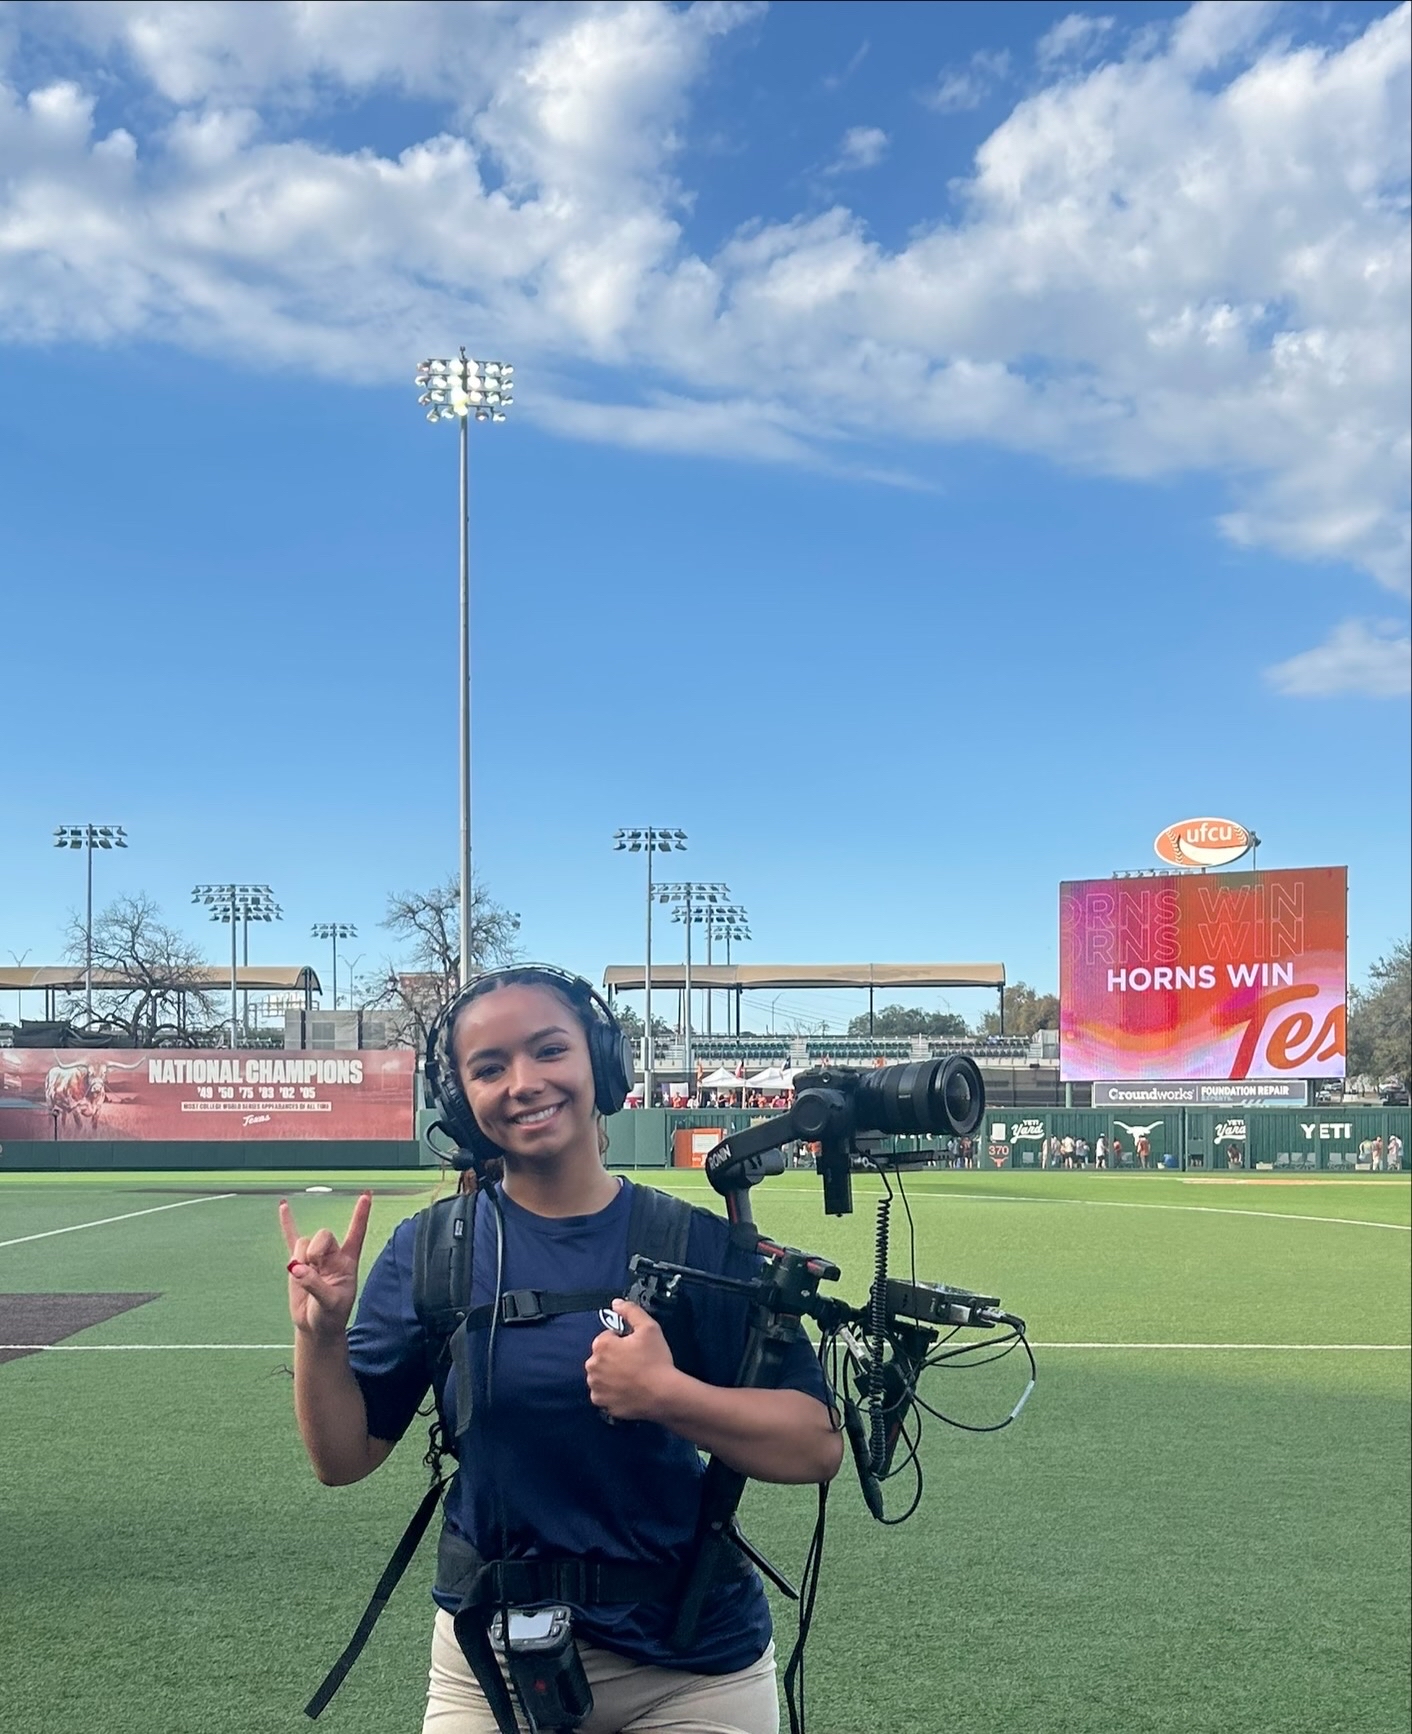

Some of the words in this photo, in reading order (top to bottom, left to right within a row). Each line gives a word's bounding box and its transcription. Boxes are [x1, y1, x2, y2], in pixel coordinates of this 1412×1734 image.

[1187, 822, 1232, 843] ufcu
[1198, 882, 1304, 924] WIN
[1198, 919, 1304, 960] WIN
[1107, 965, 1216, 992] HORNS
[1226, 962, 1294, 988] WIN
[148, 1059, 243, 1084] NATIONAL
[245, 1059, 363, 1084] CHAMPIONS
[197, 1086, 213, 1099] '49
[239, 1086, 254, 1099] '75
[1108, 1087, 1193, 1101] Groundworks
[1201, 1085, 1256, 1096] FOUNDATION
[1257, 1085, 1290, 1096] REPAIR
[242, 1114, 271, 1127] Texas
[1300, 1123, 1352, 1139] YETI
[1010, 1122, 1044, 1143] Yard
[709, 1144, 731, 1170] RONIN
[989, 1145, 1009, 1155] 370
